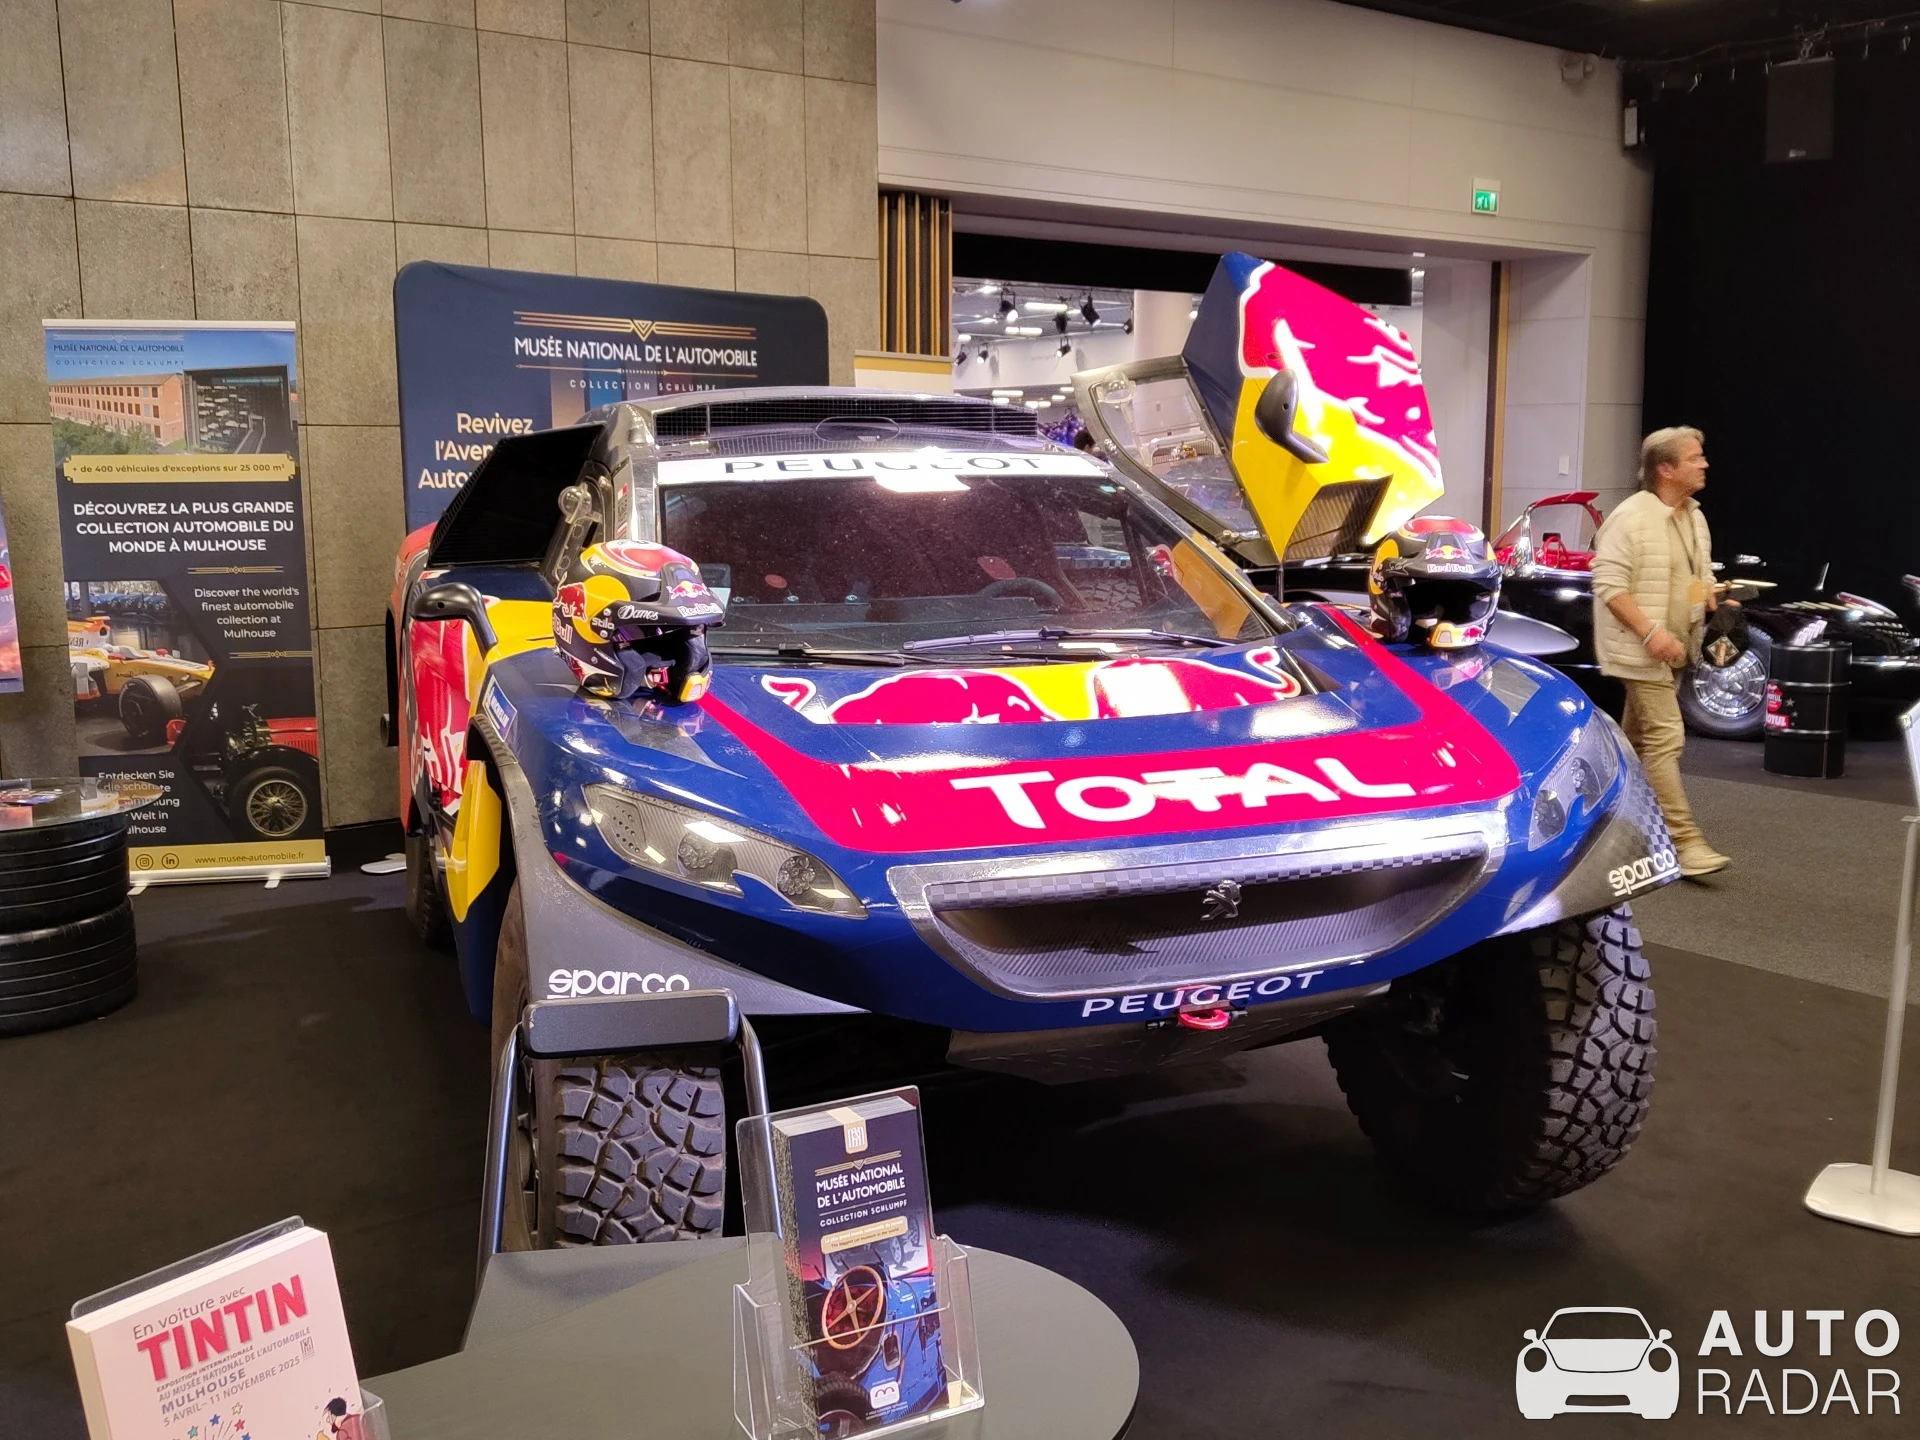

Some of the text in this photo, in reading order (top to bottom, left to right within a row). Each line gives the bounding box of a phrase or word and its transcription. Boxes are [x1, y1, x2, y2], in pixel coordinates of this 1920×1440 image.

[53, 344, 77, 352] MUSÉE
[131, 344, 184, 353] L'AUTOMOBILE
[514, 335, 758, 367] MUSÉE NATIONAL DE L'AUTOMOBILE
[569, 379, 651, 390] COLLECTION
[456, 412, 534, 434] Revivez
[80, 465, 93, 473] de
[95, 465, 113, 473] 400
[115, 464, 160, 473] véhicules
[162, 464, 221, 474] d'exceptions
[240, 464, 251, 472] 25
[418, 468, 471, 489] Auto
[73, 501, 294, 516] DÉCOUVREZ LA PLUS GRANDE
[76, 519, 294, 535] COLLECTION AUTOMOBILE DU
[109, 537, 267, 553] MONDE À MULHOUSE
[194, 586, 300, 598] Discover the world's
[201, 600, 295, 611] finest automobile
[216, 614, 282, 625] collection at
[591, 616, 615, 631] stilo
[223, 629, 277, 639] Mulhouse
[98, 769, 175, 780] Entdecken Sie
[950, 757, 1416, 830] TOTAL
[130, 810, 156, 821] Welt
[158, 810, 169, 820] in
[194, 851, 306, 865] www.musee-automobile.fr
[1608, 848, 1678, 896] sparco
[547, 968, 690, 999] sparco
[1081, 970, 1325, 1018] PEUGEOT
[816, 1162, 904, 1194] MUSÉE NATIONAL
[816, 1176, 906, 1209] DE L'AUTOMOBILE
[819, 1199, 908, 1228] COLLECTION SCHLUMPF
[132, 1286, 246, 1340] En voiture avec
[136, 1274, 308, 1382] TINTIN
[156, 1345, 254, 1393] EXPOSITION INTERNATIONALE
[158, 1392, 171, 1402] AU
[172, 1375, 202, 1397] MUSÉE
[202, 1359, 244, 1384] NATIONAL
[245, 1353, 256, 1364] DE
[257, 1326, 311, 1358] L'AUTOMOBILE
[161, 1367, 247, 1415] MULHOUSE
[163, 1417, 171, 1428] 5
[172, 1402, 201, 1422] AVRIL
[209, 1393, 221, 1406] 11
[222, 1366, 277, 1400] NOVEMBRE
[278, 1355, 301, 1374] 2025
